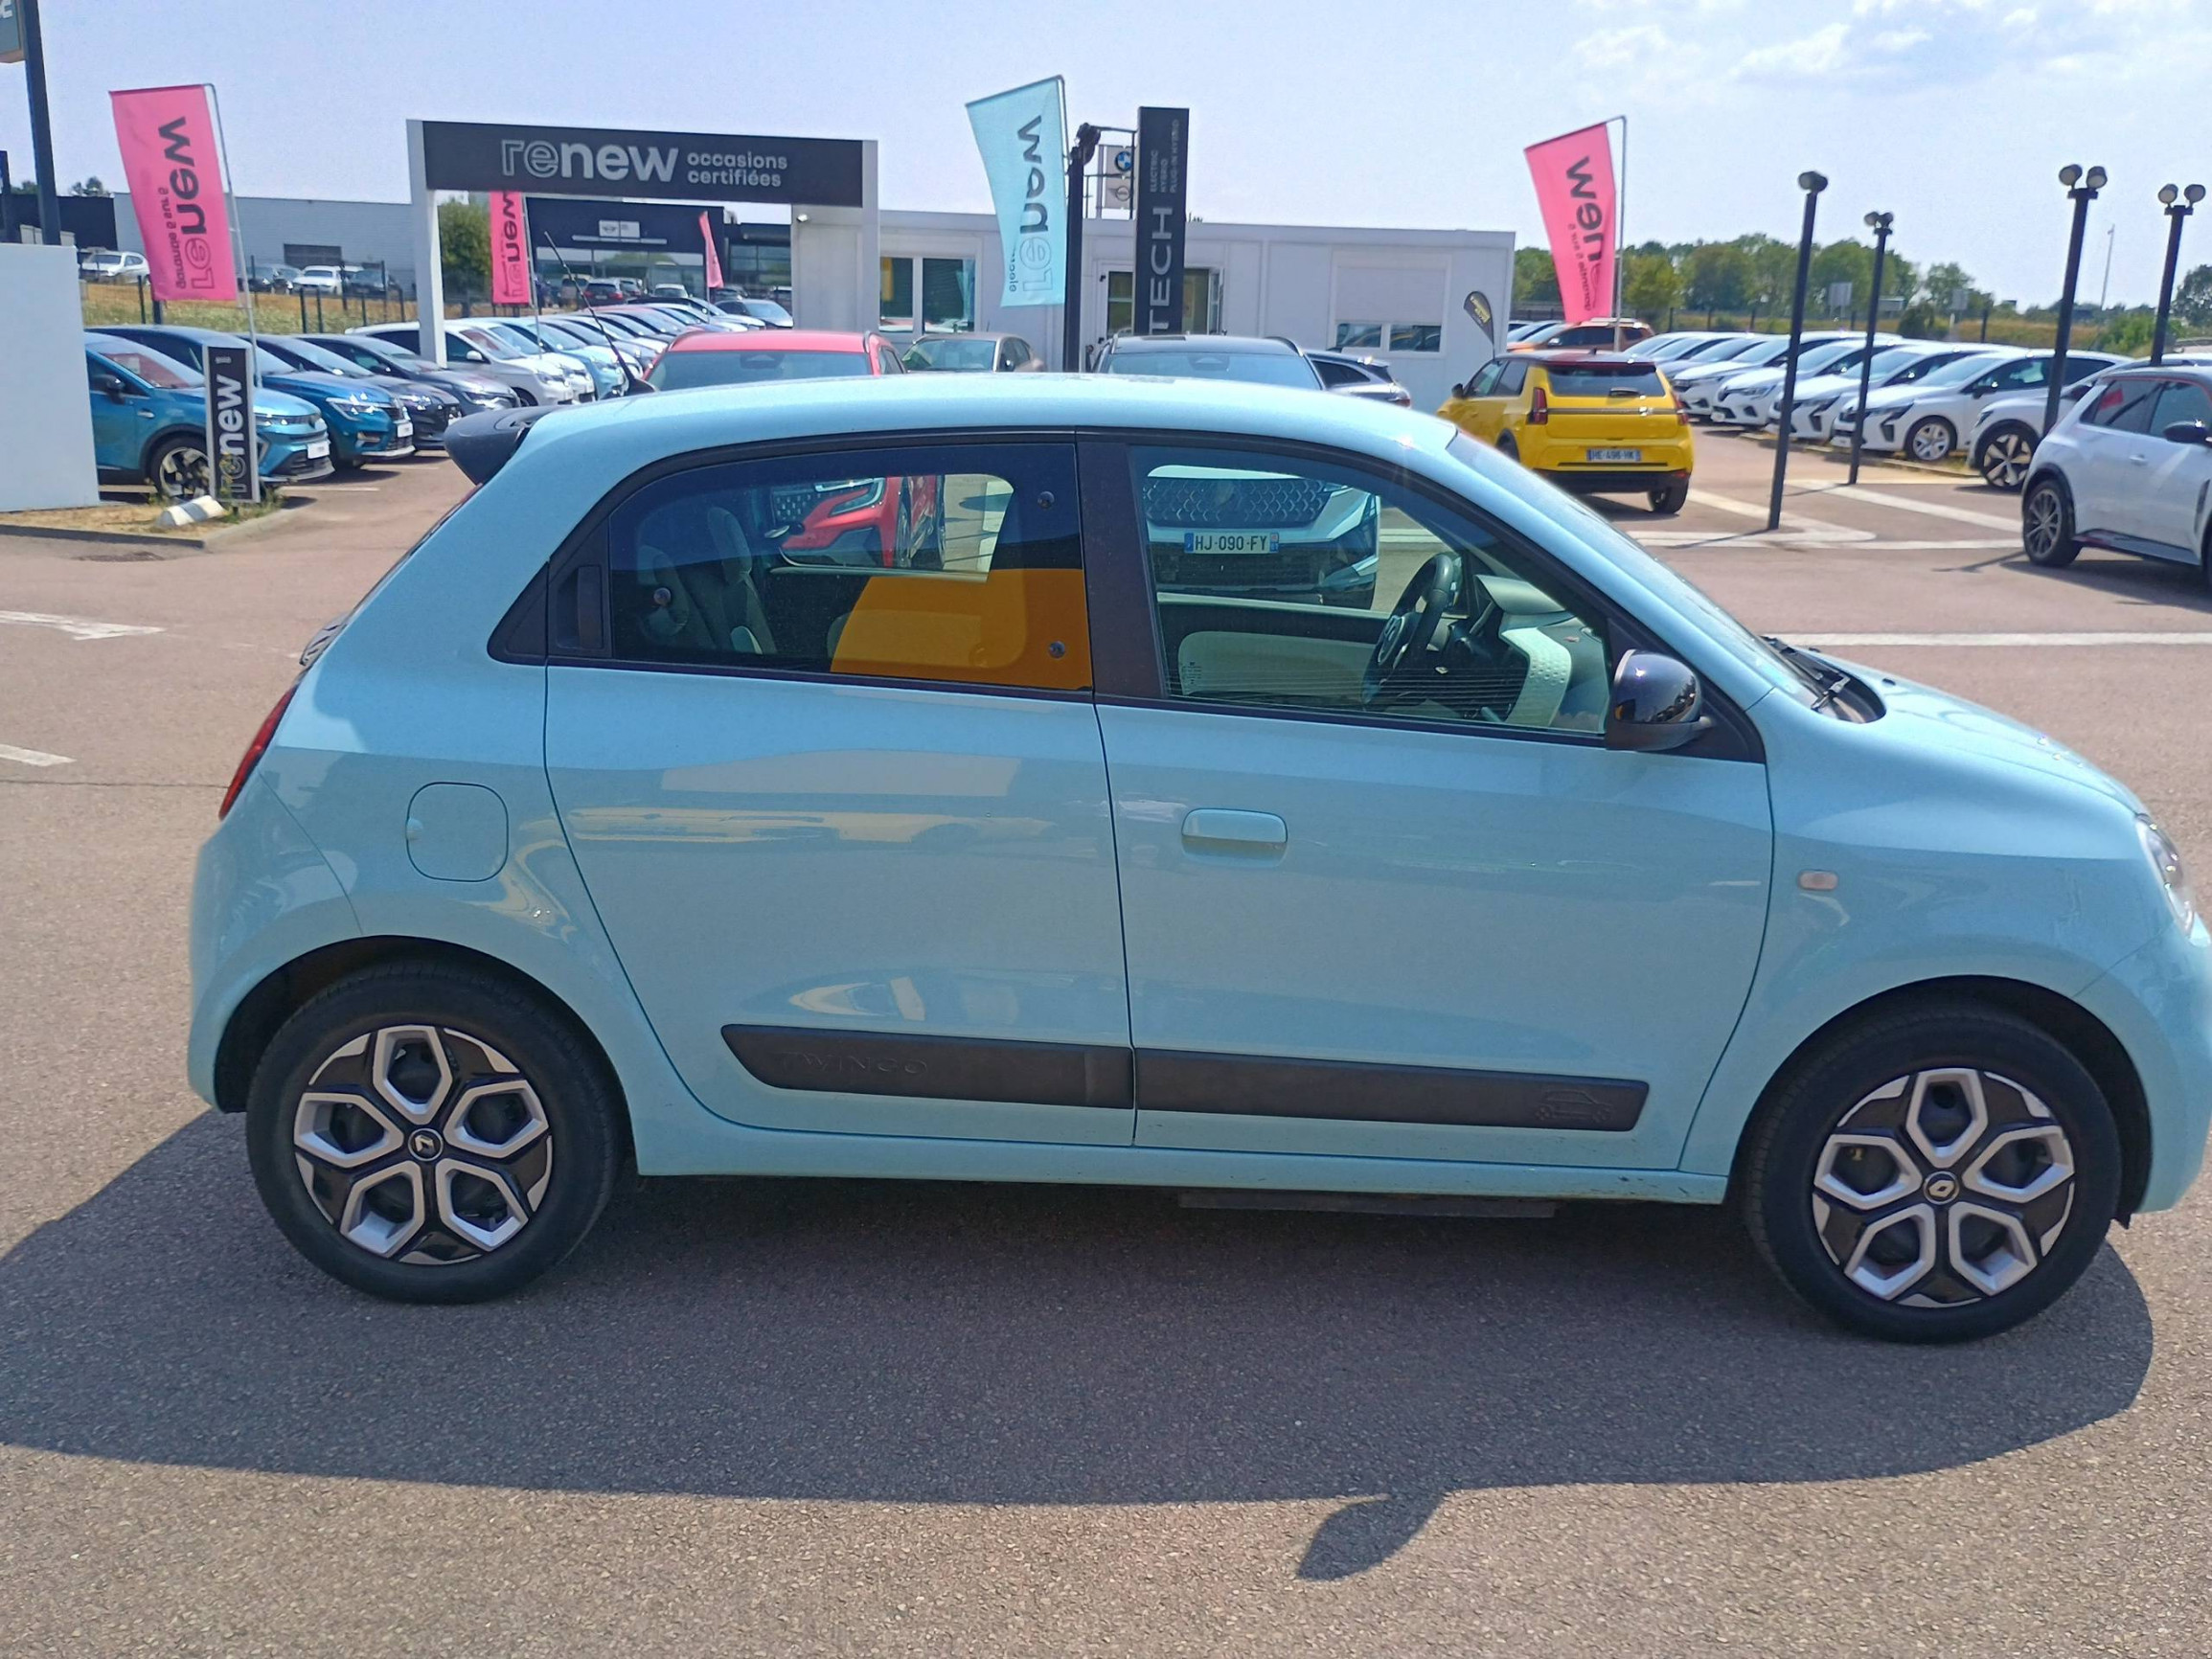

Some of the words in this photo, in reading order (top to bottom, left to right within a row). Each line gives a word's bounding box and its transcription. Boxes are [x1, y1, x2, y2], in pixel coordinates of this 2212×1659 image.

[501, 139, 679, 183] renew
[687, 151, 787, 170] occasions
[687, 168, 782, 187] certifiées
[1196, 535, 1267, 551] HJ-090-FY
